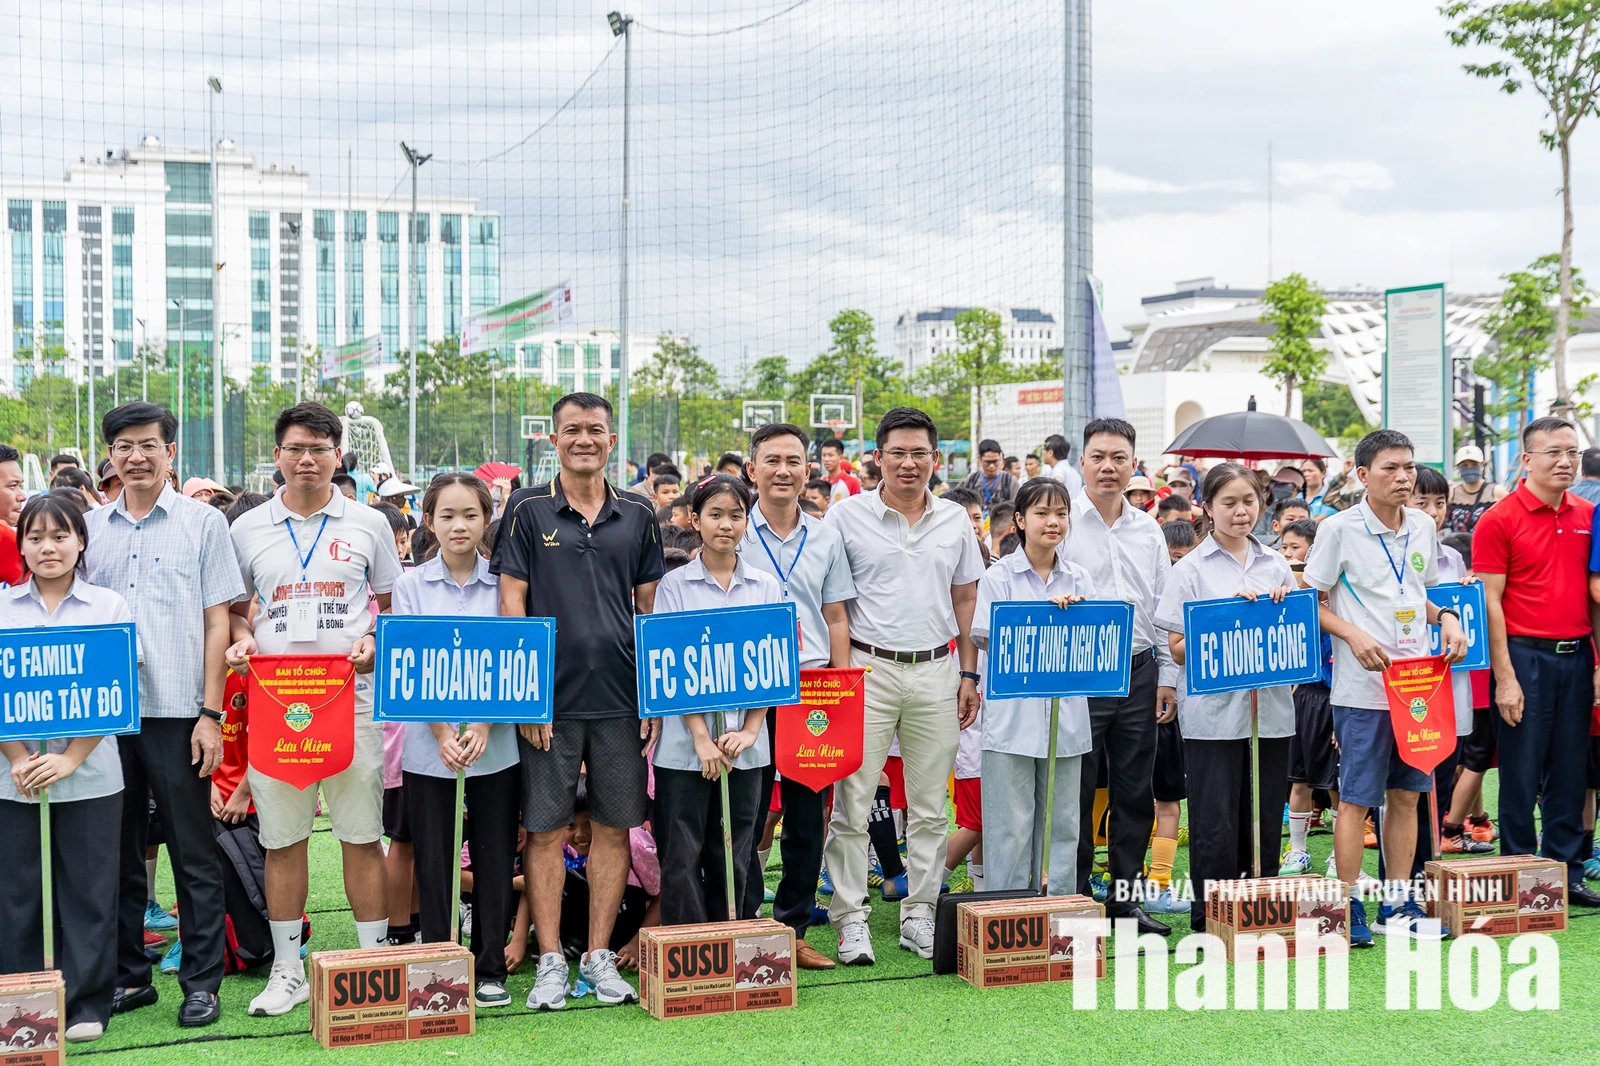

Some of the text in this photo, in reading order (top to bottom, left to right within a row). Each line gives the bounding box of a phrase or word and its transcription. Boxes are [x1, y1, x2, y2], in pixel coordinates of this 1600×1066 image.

[314, 582, 345, 598] SPORTS
[998, 615, 1120, 684] FC VIỆT HÙNG NGHI SƠN
[1200, 608, 1307, 679] FC NÔNG CỐNG
[20, 644, 85, 678] FAMILY
[276, 665, 327, 676] BAN TỔ CHỨC
[390, 628, 540, 701] FC HOẰNG HÓA
[649, 626, 790, 700] FC SẦM SƠN
[814, 678, 821, 688] TỔ
[823, 679, 841, 688] CHỨC
[4, 680, 122, 724] LONG TÂY ĐÔ
[274, 737, 332, 755] Lưu Niệm
[796, 744, 844, 760] Lưu Niệm
[1242, 896, 1292, 927] SUSU
[987, 917, 1043, 950] SUSU
[668, 943, 728, 979] SUSU
[334, 968, 400, 1006] SUSU
